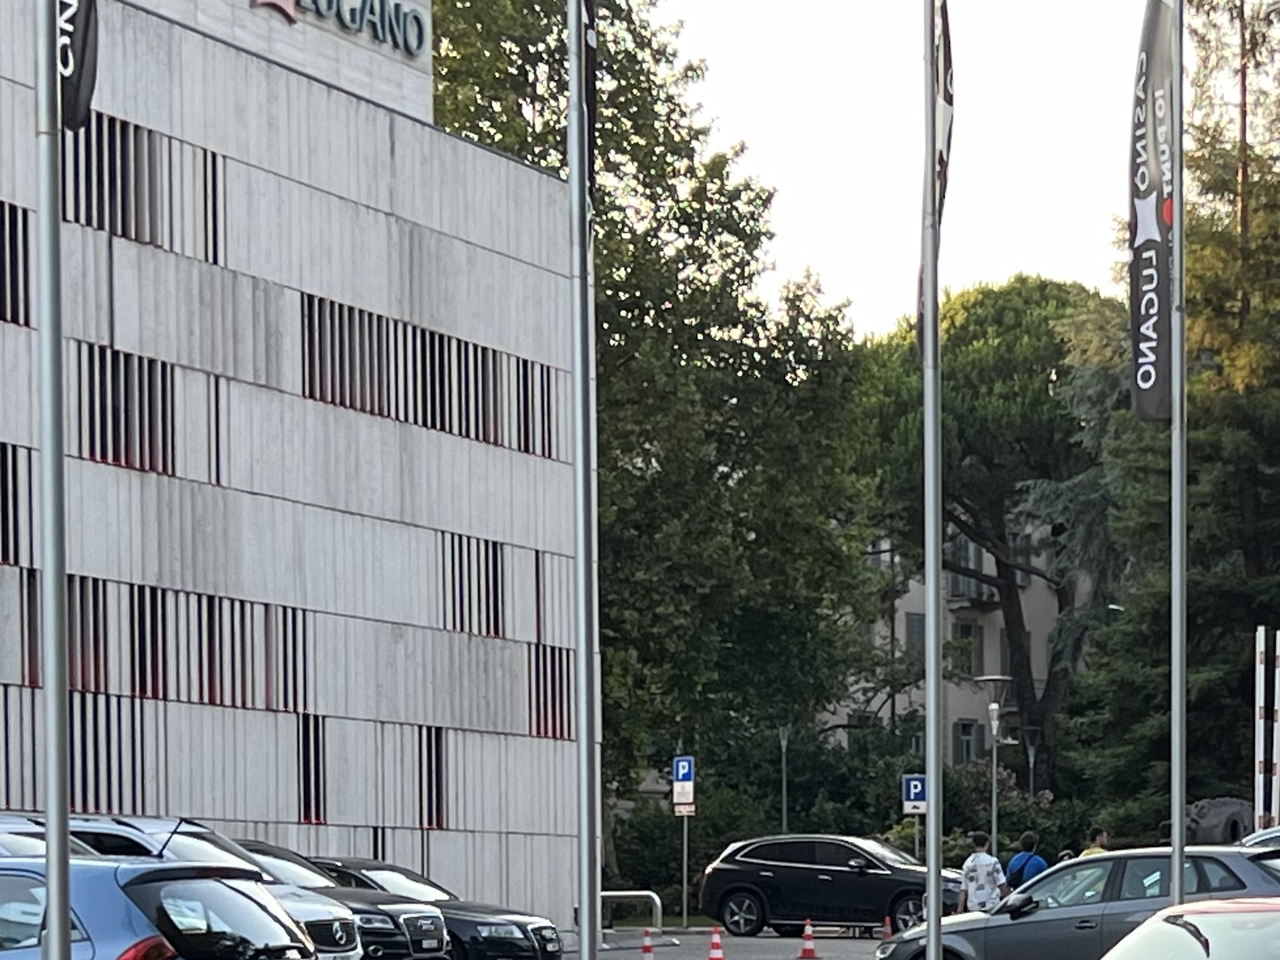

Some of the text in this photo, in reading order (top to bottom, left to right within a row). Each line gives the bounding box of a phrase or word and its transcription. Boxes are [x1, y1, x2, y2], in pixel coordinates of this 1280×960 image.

[296, 0, 424, 57] GANO
[678, 761, 689, 780] P
[910, 780, 922, 800] P
